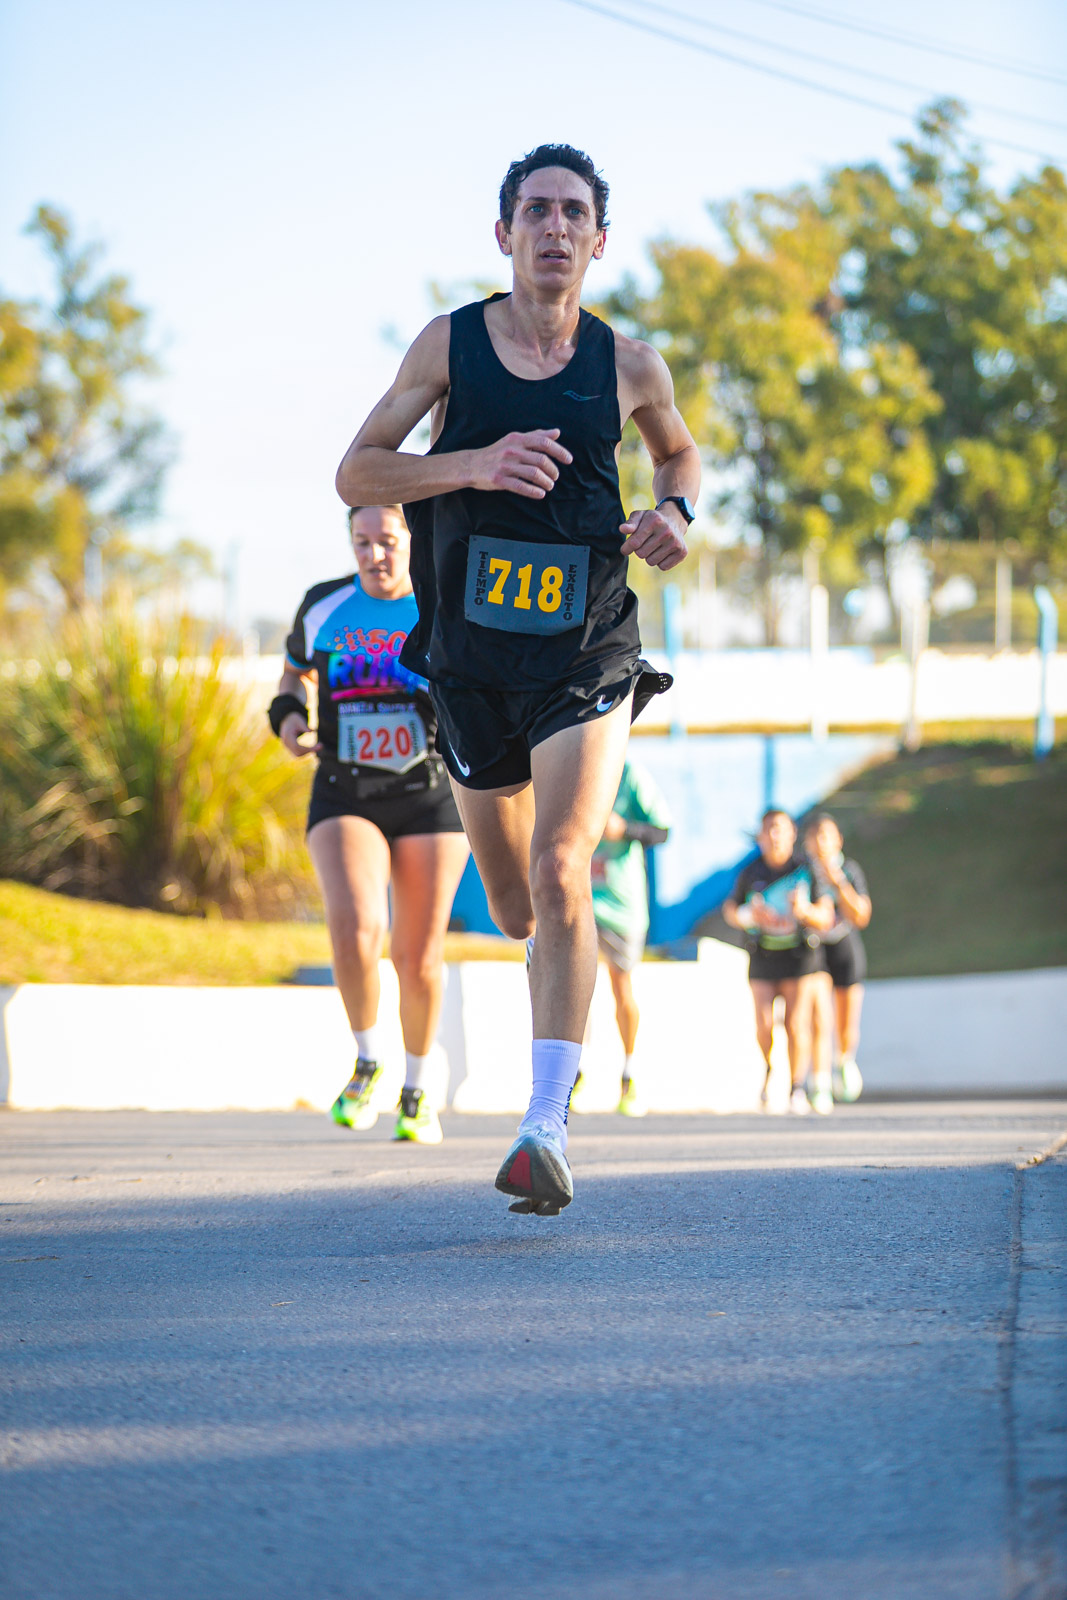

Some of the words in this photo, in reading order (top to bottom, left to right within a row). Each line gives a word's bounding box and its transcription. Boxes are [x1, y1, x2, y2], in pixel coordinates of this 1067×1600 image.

[473, 551, 489, 606] TIEMPO
[487, 557, 564, 613] 718
[563, 564, 578, 621] EXACTO
[357, 726, 413, 761] 220
